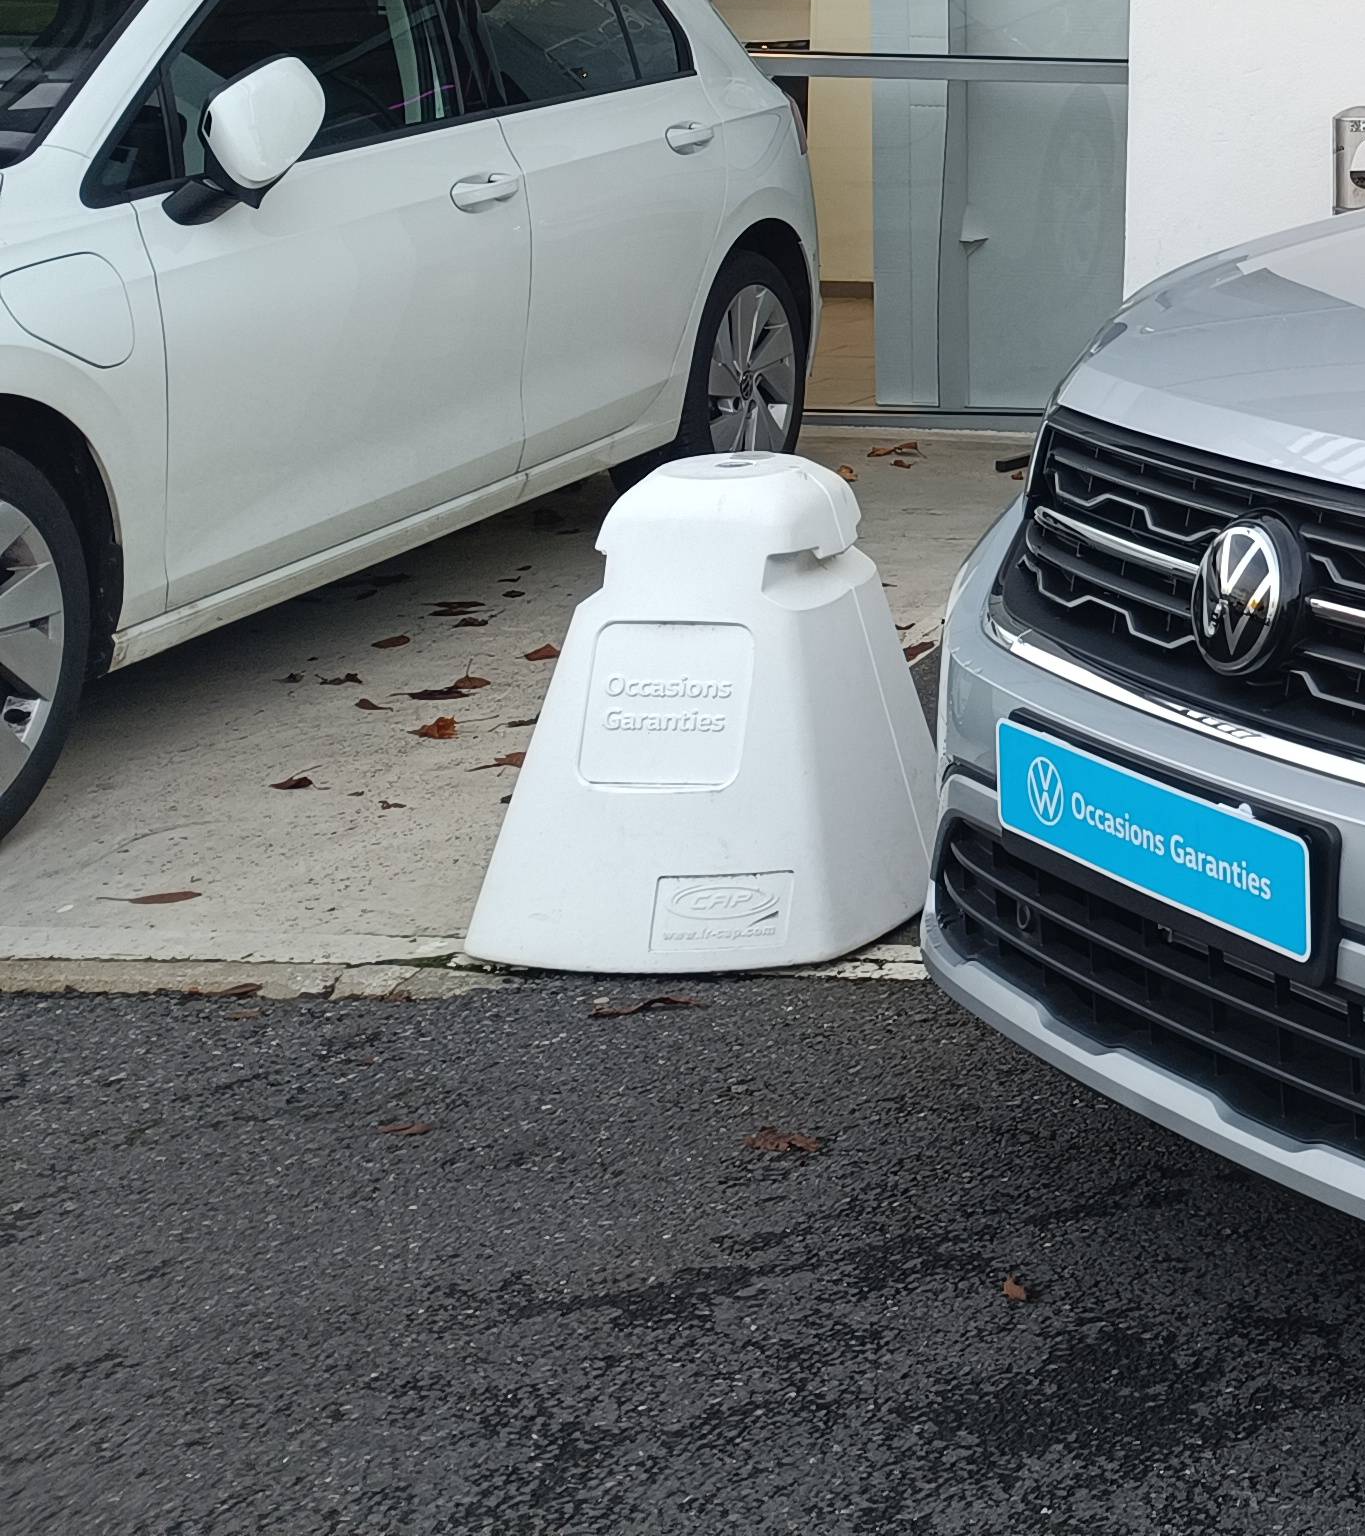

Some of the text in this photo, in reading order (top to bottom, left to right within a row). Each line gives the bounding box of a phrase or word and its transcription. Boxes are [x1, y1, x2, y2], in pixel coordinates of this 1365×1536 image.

[604, 675, 733, 699] Occasions
[602, 709, 726, 732] Garanties
[1071, 791, 1166, 857] Occasions
[1169, 834, 1272, 901] Garanties
